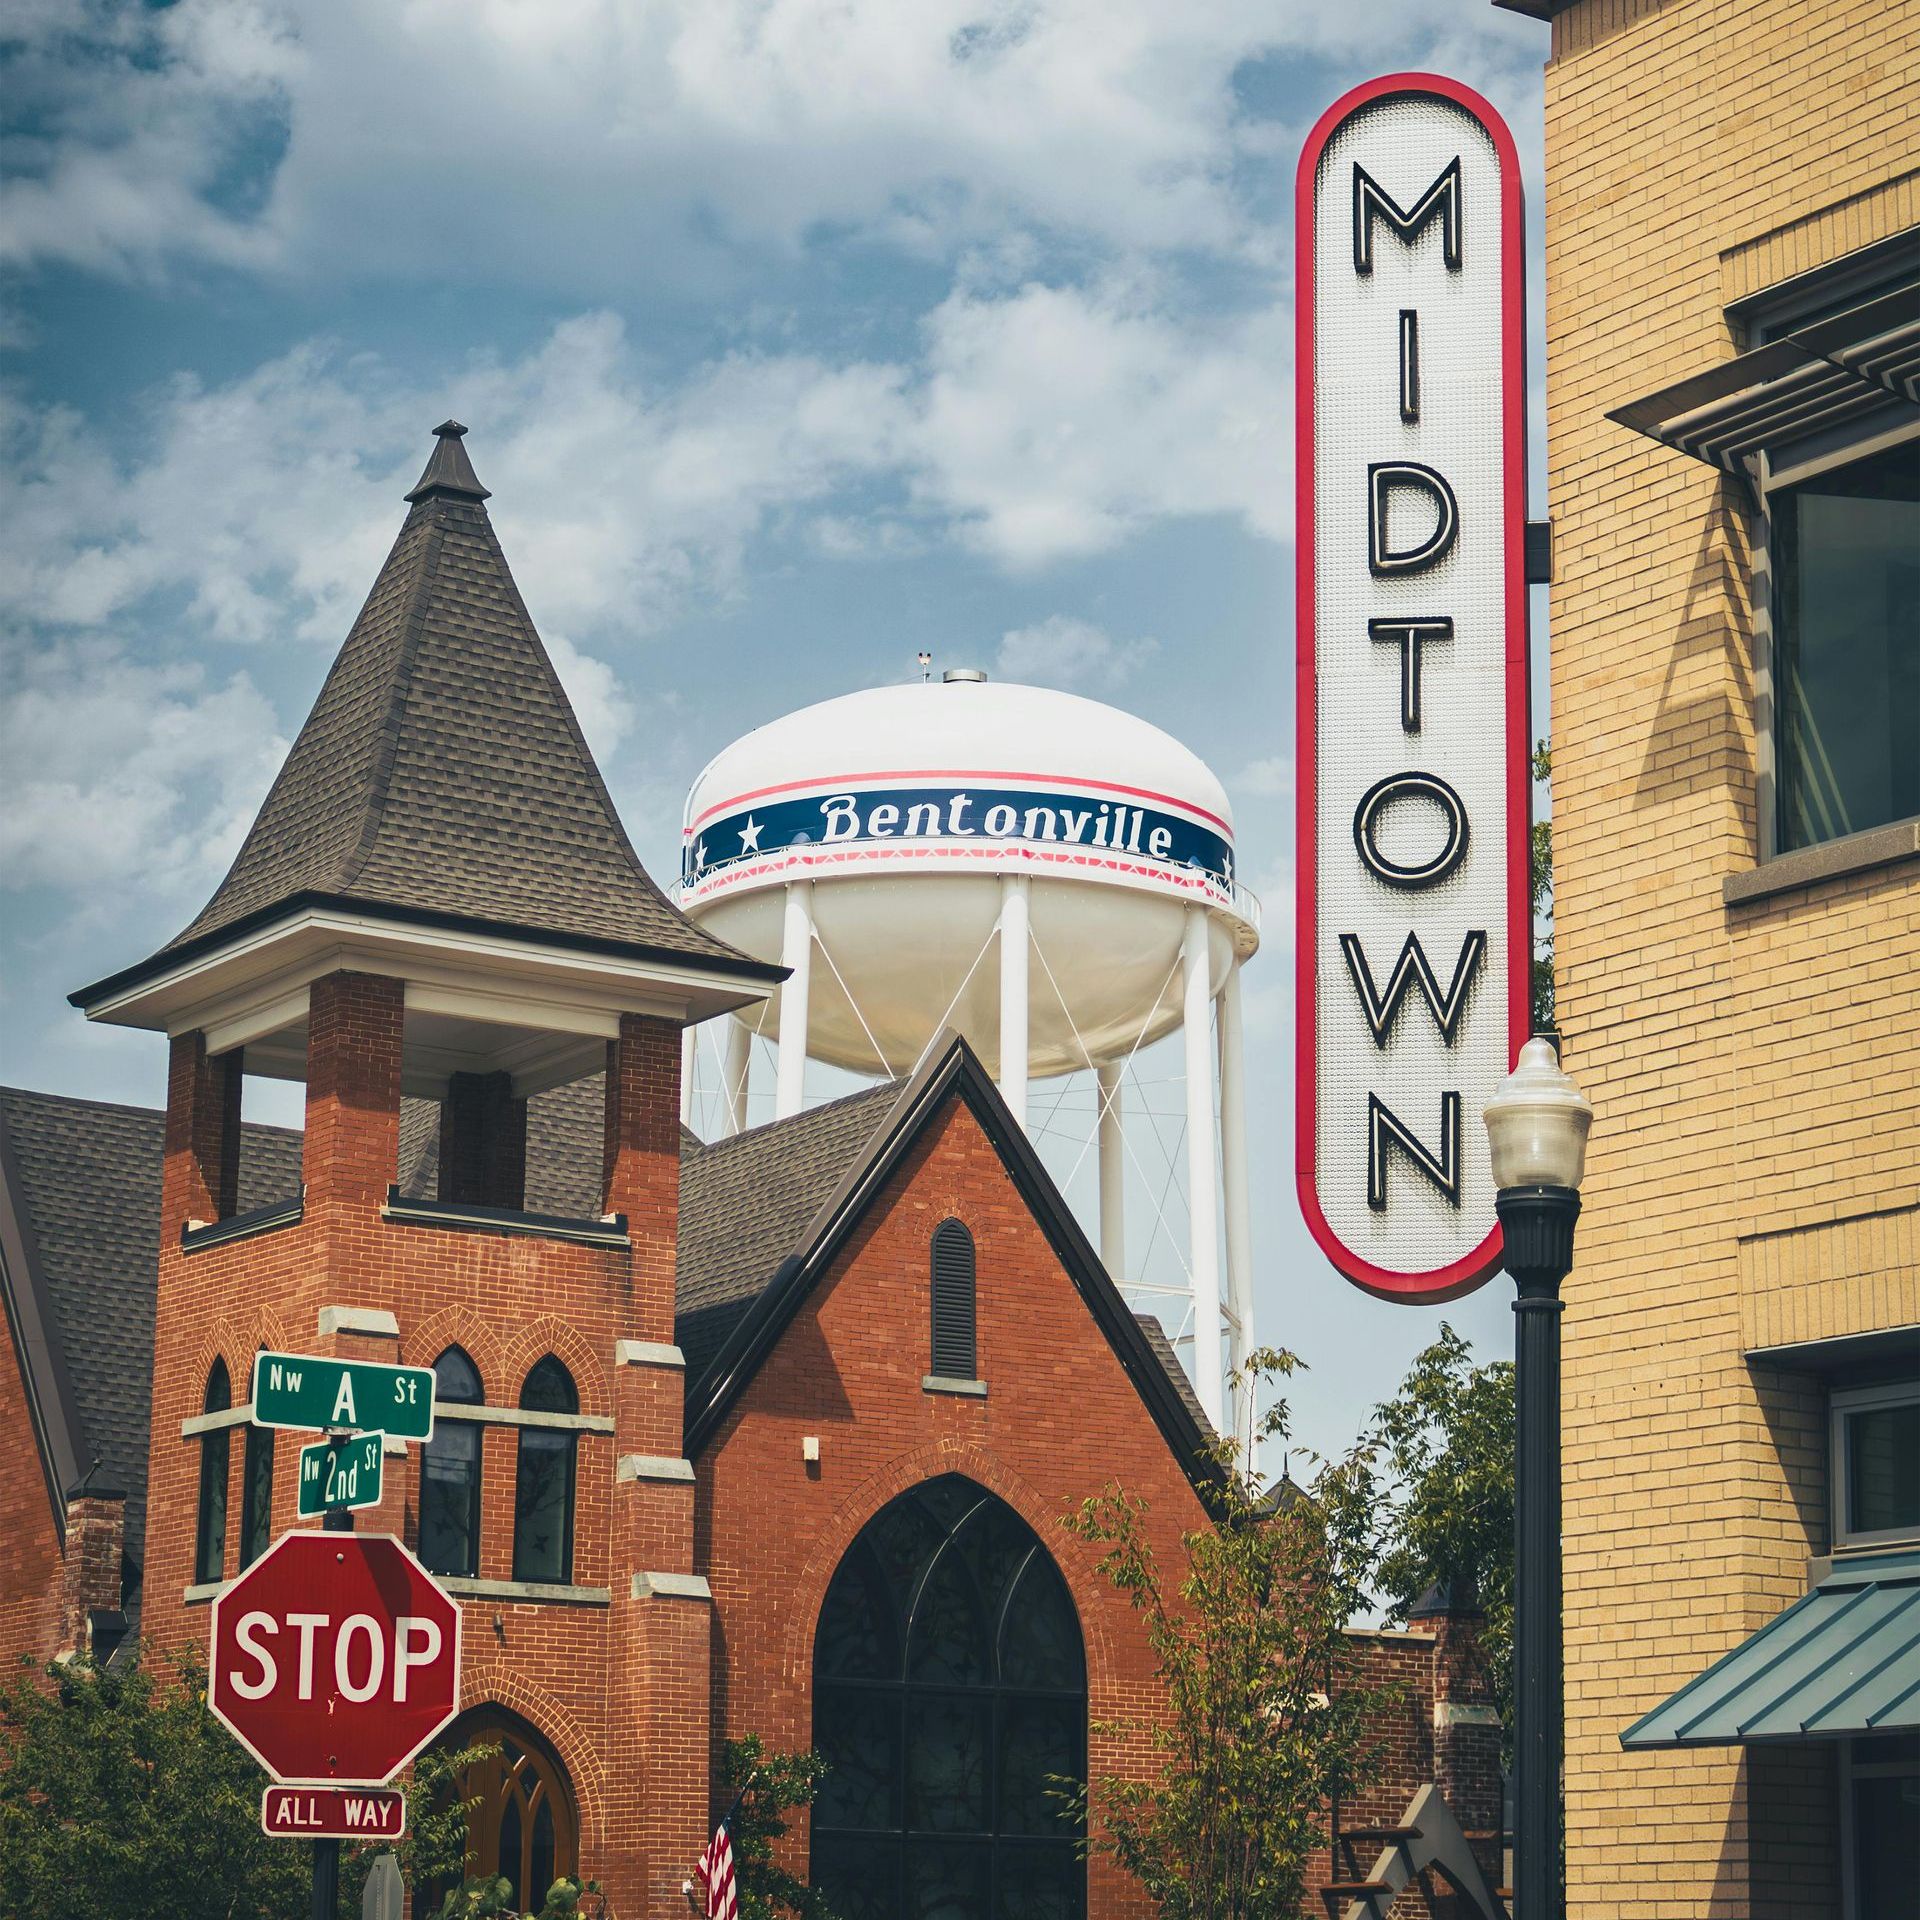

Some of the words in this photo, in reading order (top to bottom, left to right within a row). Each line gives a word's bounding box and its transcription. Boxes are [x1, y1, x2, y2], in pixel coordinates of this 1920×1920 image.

[1340, 155, 1486, 1210] MIDTOWN
[820, 793, 1173, 857] Bentonville
[331, 1371, 357, 1423] A
[394, 1377, 417, 1404] St
[325, 1451, 357, 1502] 2nd
[364, 1443, 377, 1471] St
[229, 1611, 442, 1703] STOP
[275, 1797, 323, 1826] ALL
[344, 1799, 393, 1827] WAY
